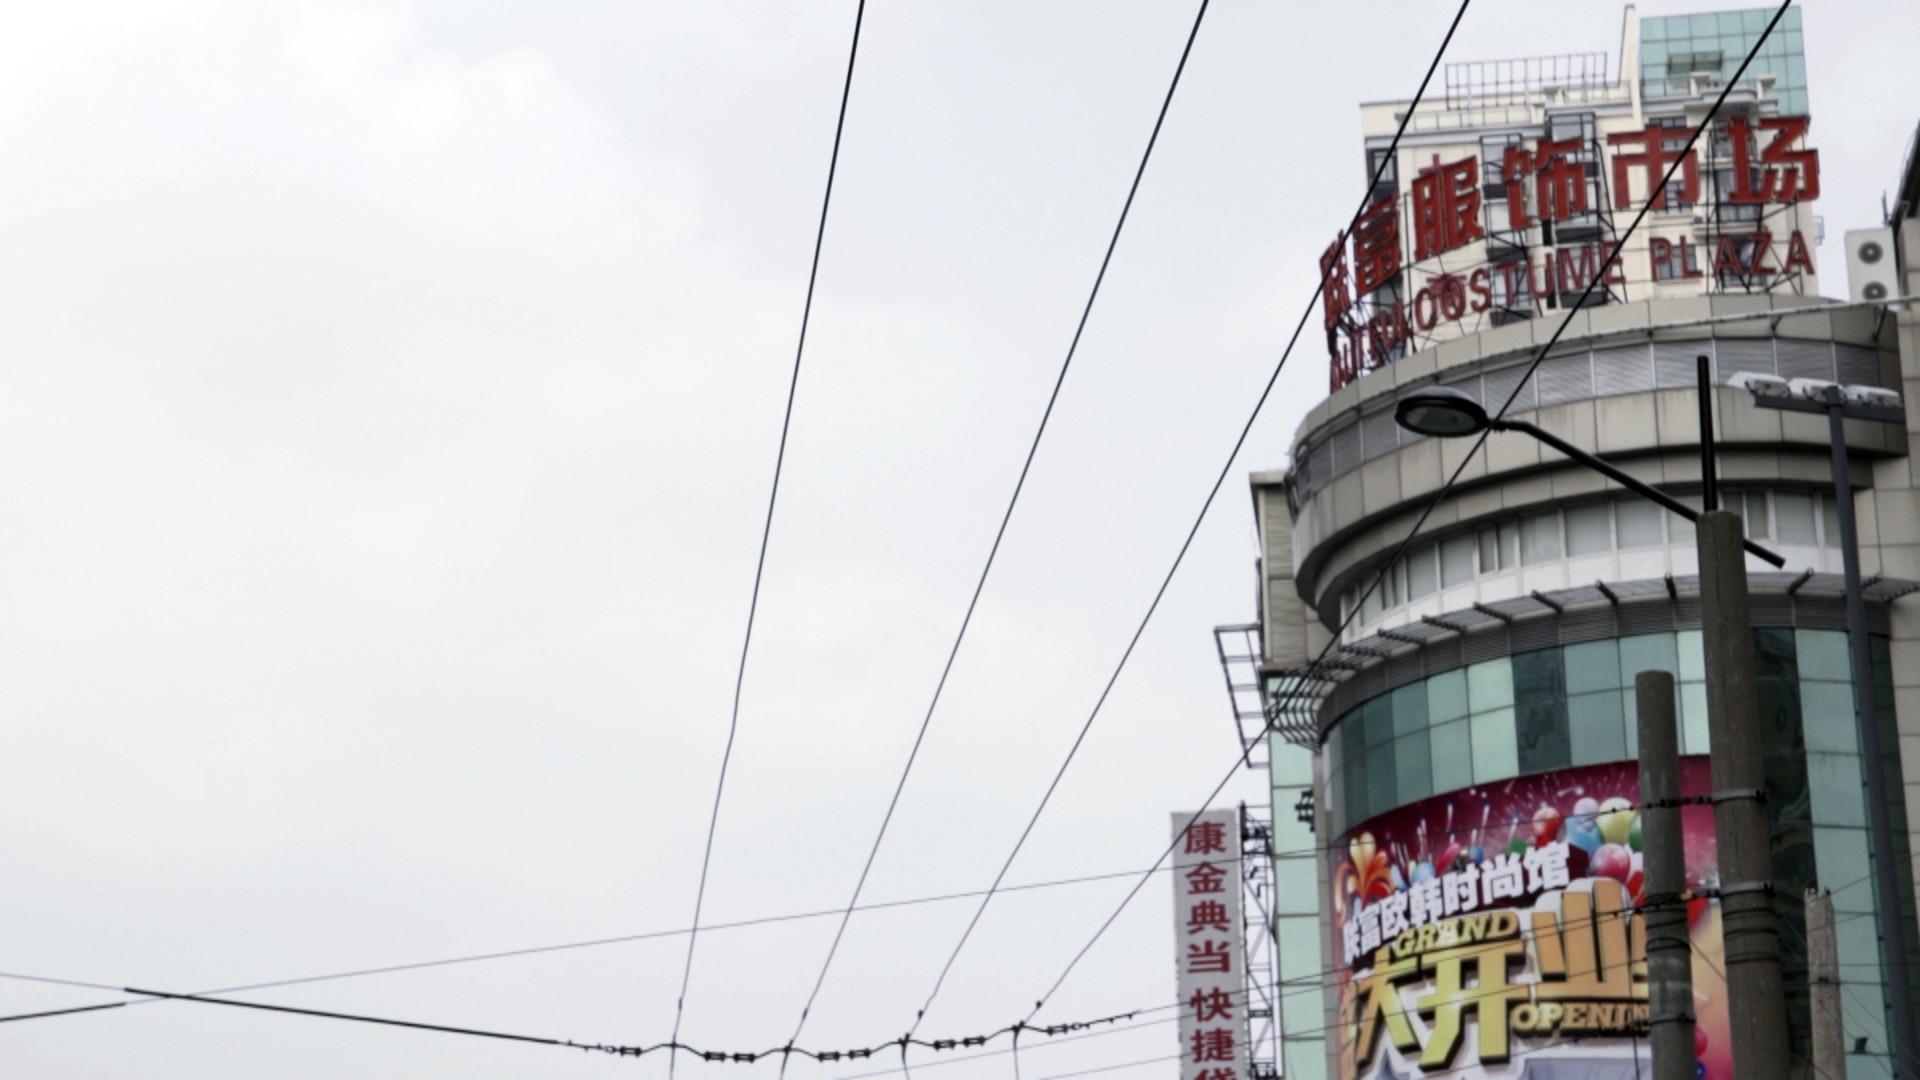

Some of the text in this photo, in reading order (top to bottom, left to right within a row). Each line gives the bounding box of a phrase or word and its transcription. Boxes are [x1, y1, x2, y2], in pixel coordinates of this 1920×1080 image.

[1650, 229, 1815, 282] PLAZA
[1184, 821, 1231, 974] 康金典当
[1394, 911, 1520, 955] GRAND
[1511, 1001, 1649, 1035] OPENIN
